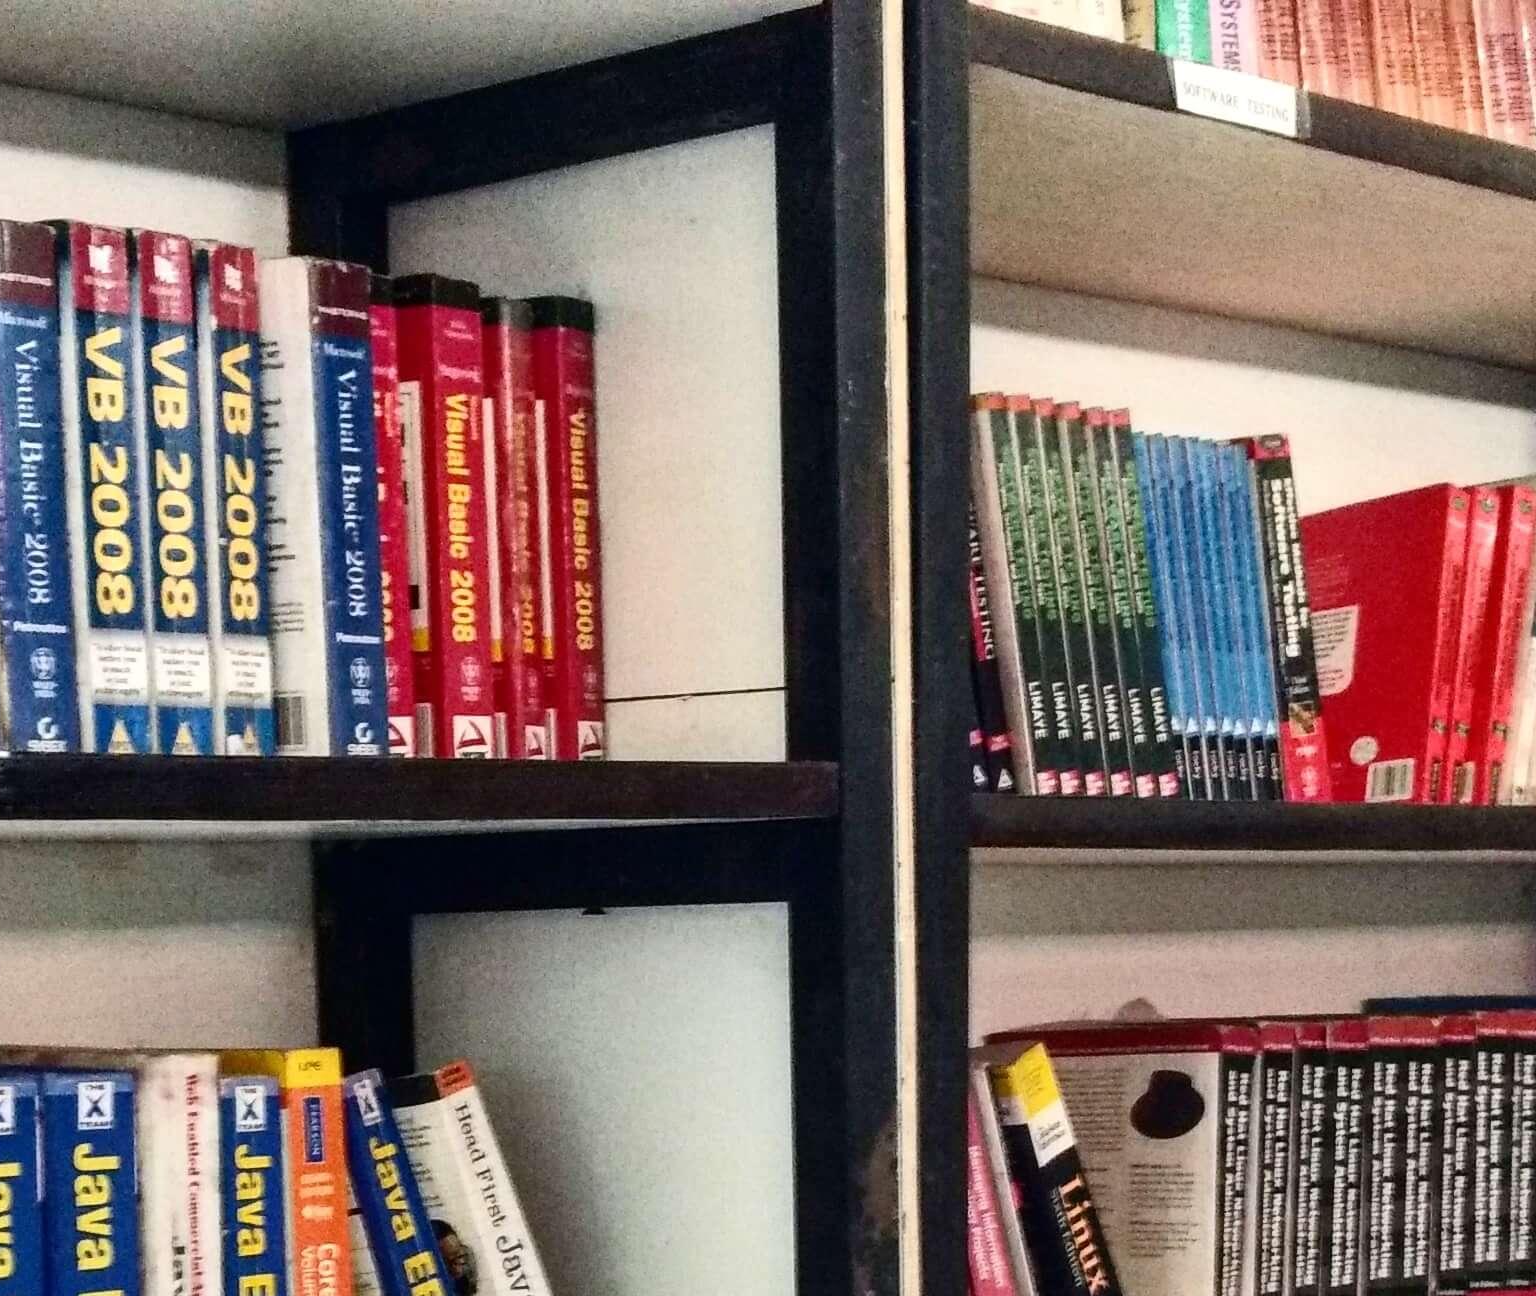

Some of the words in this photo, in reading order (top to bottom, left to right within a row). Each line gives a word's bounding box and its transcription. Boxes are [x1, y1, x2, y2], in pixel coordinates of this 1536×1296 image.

[1181, 79, 1240, 113] SOFTWARE
[1246, 97, 1290, 124] TESTING
[84, 326, 126, 423] VB
[150, 334, 190, 430] VB
[220, 343, 253, 436] VB
[336, 369, 362, 453] Visual
[445, 393, 472, 477] Visual
[569, 407, 589, 490] Visual
[88, 442, 135, 616] 2008
[154, 448, 199, 620] 2008
[224, 453, 261, 622] 2008
[447, 483, 475, 559] Basic
[571, 497, 592, 571] Basic
[24, 532, 52, 606] 2008
[345, 550, 369, 617] 2008
[449, 569, 477, 643] 2008
[574, 580, 595, 651] 2008
[1028, 681, 1049, 741] LIMAYE
[1051, 681, 1072, 741] LIMAYE
[1076, 682, 1096, 743] LIMAYE
[1102, 683, 1122, 743] LIMAYE
[1126, 688, 1148, 746] LIMAYE
[1150, 685, 1170, 745] LIMAYE
[234, 1144, 273, 1257] Java
[369, 1137, 417, 1242] Java
[455, 1102, 485, 1167] Head
[477, 1167, 504, 1228] First
[73, 1142, 123, 1272] Java
